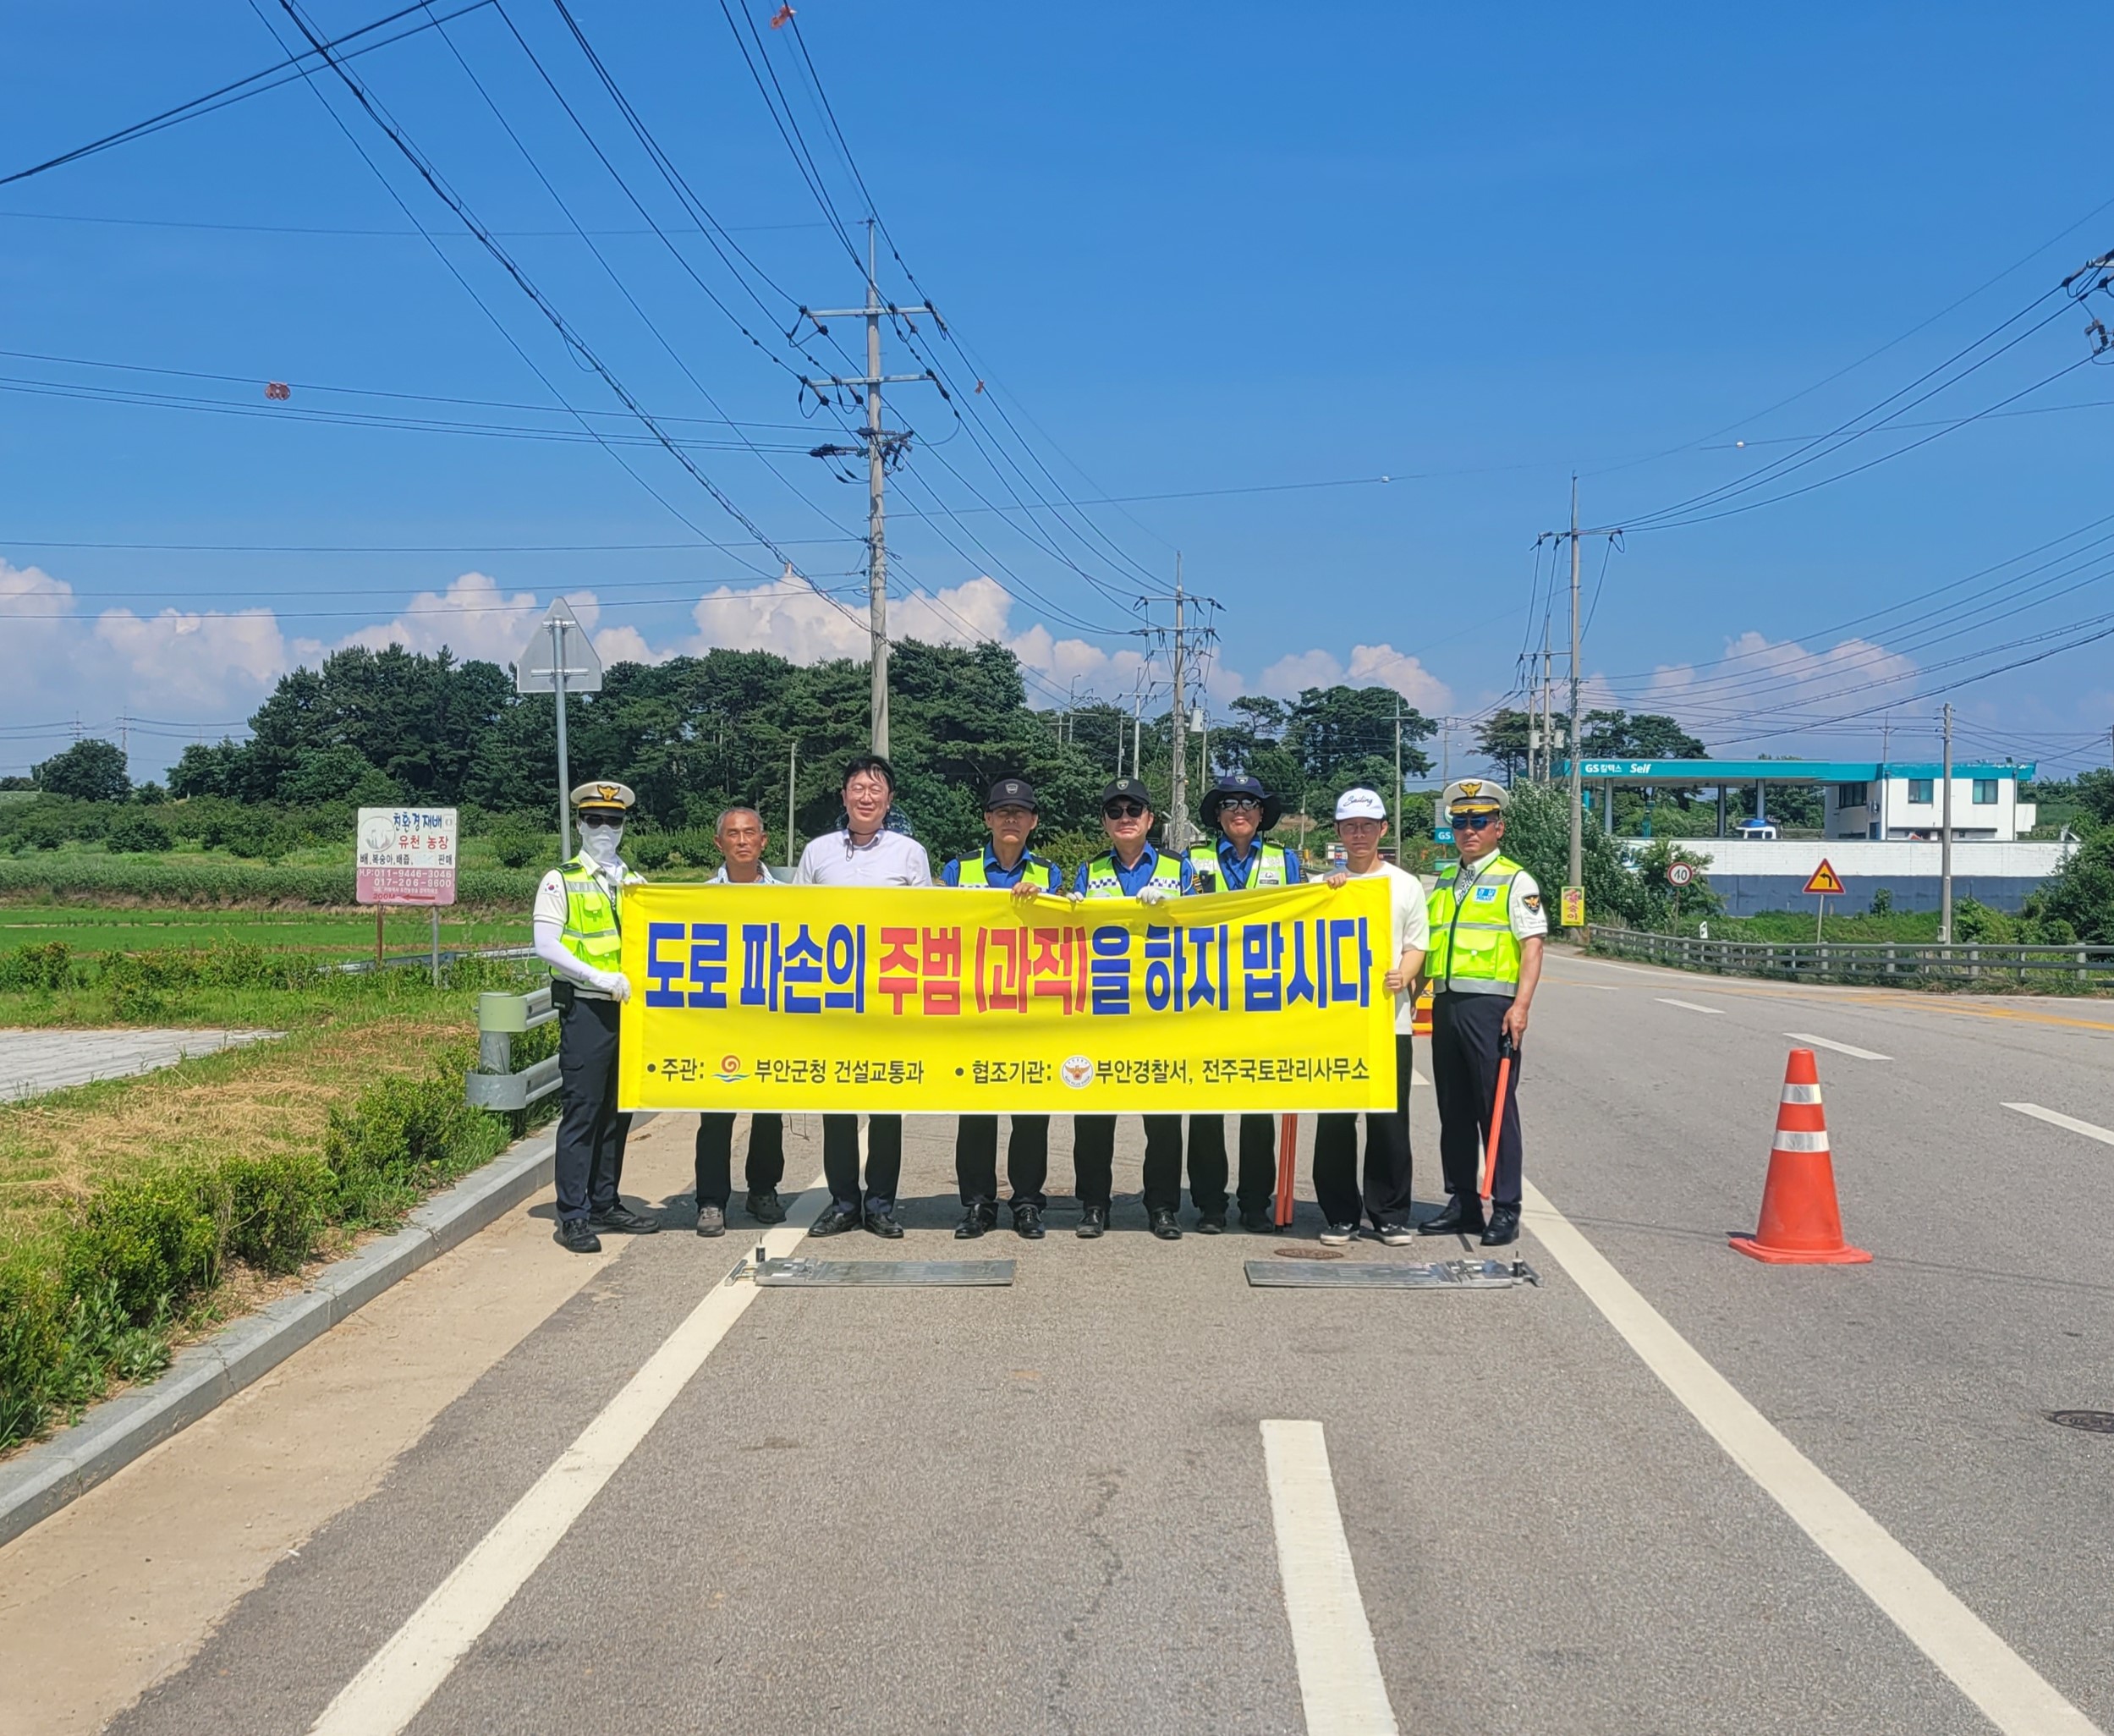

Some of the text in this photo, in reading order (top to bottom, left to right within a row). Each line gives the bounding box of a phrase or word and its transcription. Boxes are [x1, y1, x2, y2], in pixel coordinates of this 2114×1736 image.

[1629, 763, 1651, 774] Self
[1343, 795, 1373, 807] Sailing
[398, 835, 449, 850] 유천 농장
[438, 854, 453, 865] 판매
[645, 916, 1373, 1016] 도로 파손의 주범 (과적)을 하지 맙시다
[661, 1058, 924, 1085] 주관: 부안군청 건설교통과
[972, 1059, 1052, 1085] 협조기관:
[1095, 1059, 1193, 1087] 부안경찰서,
[1202, 1057, 1370, 1084] 전주국토관리사무소
